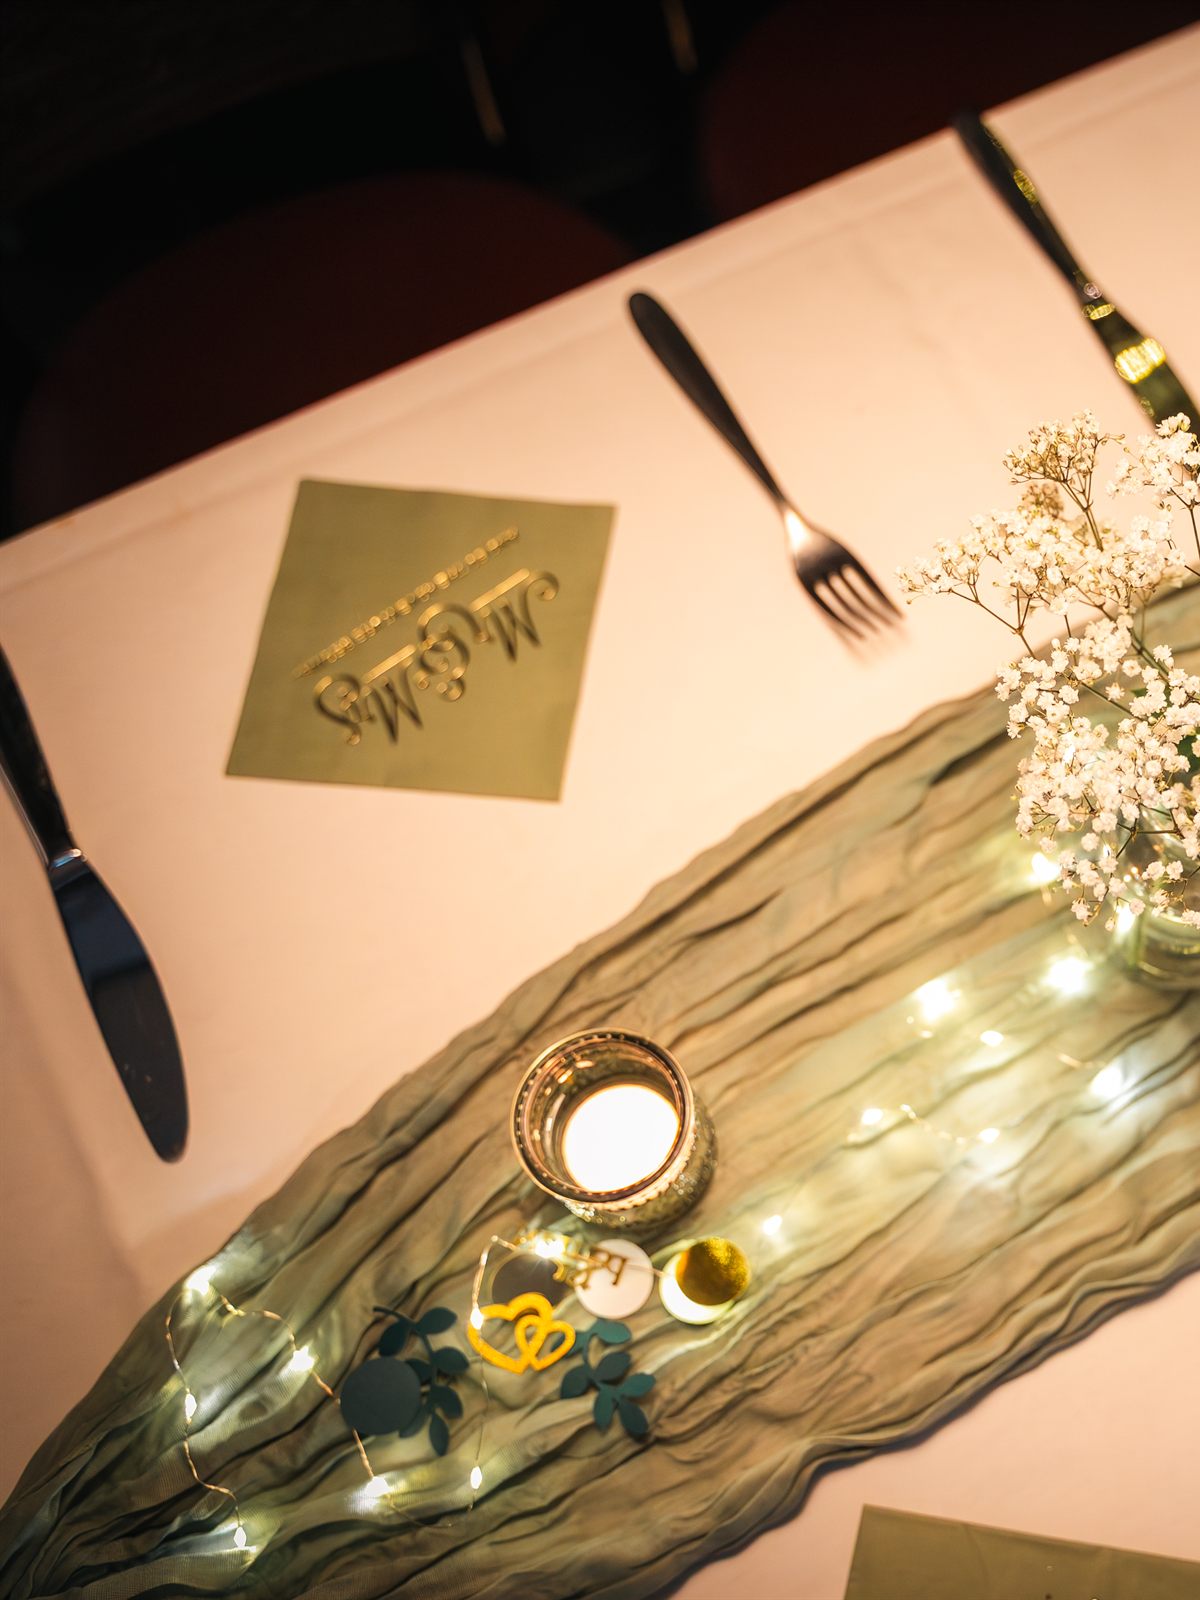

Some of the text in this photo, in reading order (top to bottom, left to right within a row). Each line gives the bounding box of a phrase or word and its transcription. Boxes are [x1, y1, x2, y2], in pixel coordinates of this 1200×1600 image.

[418, 601, 487, 701] &
[472, 567, 560, 662] Mr
[313, 644, 429, 745] Mrs
